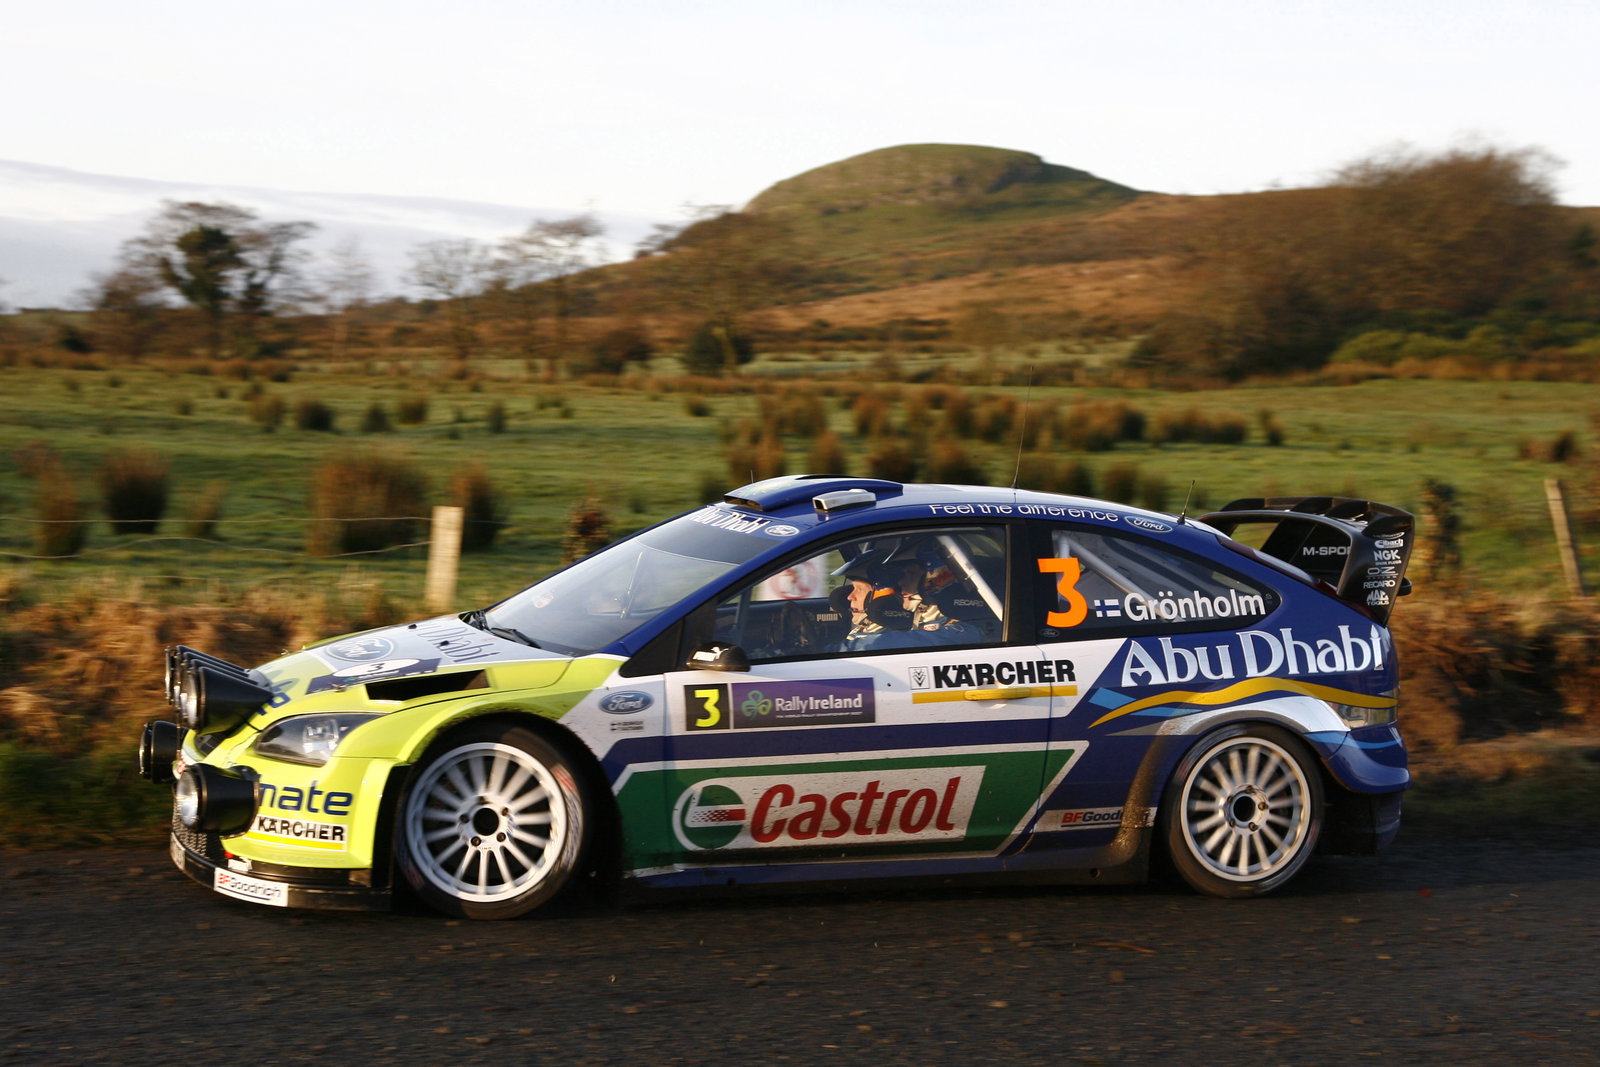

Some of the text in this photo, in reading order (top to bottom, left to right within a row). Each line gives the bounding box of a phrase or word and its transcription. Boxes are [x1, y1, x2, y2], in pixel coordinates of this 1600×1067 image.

[929, 503, 1119, 522] Feel the difference
[1303, 546, 1351, 556] M-SPO
[1373, 549, 1401, 561] NGK
[1037, 557, 1088, 628] 3
[1364, 579, 1396, 589] RECARO
[1367, 589, 1389, 601] MAC
[1124, 588, 1267, 622] Grönholm
[1121, 624, 1384, 688] Abu Dhabi
[933, 659, 1076, 689] KÄRCHER
[694, 688, 721, 728] 3
[775, 693, 863, 713] Rally Ireland
[751, 776, 961, 843] Castrol
[1062, 809, 1122, 824] BFGood
[258, 816, 345, 841] KÄRCHER
[217, 873, 282, 898] BFGoodrich
